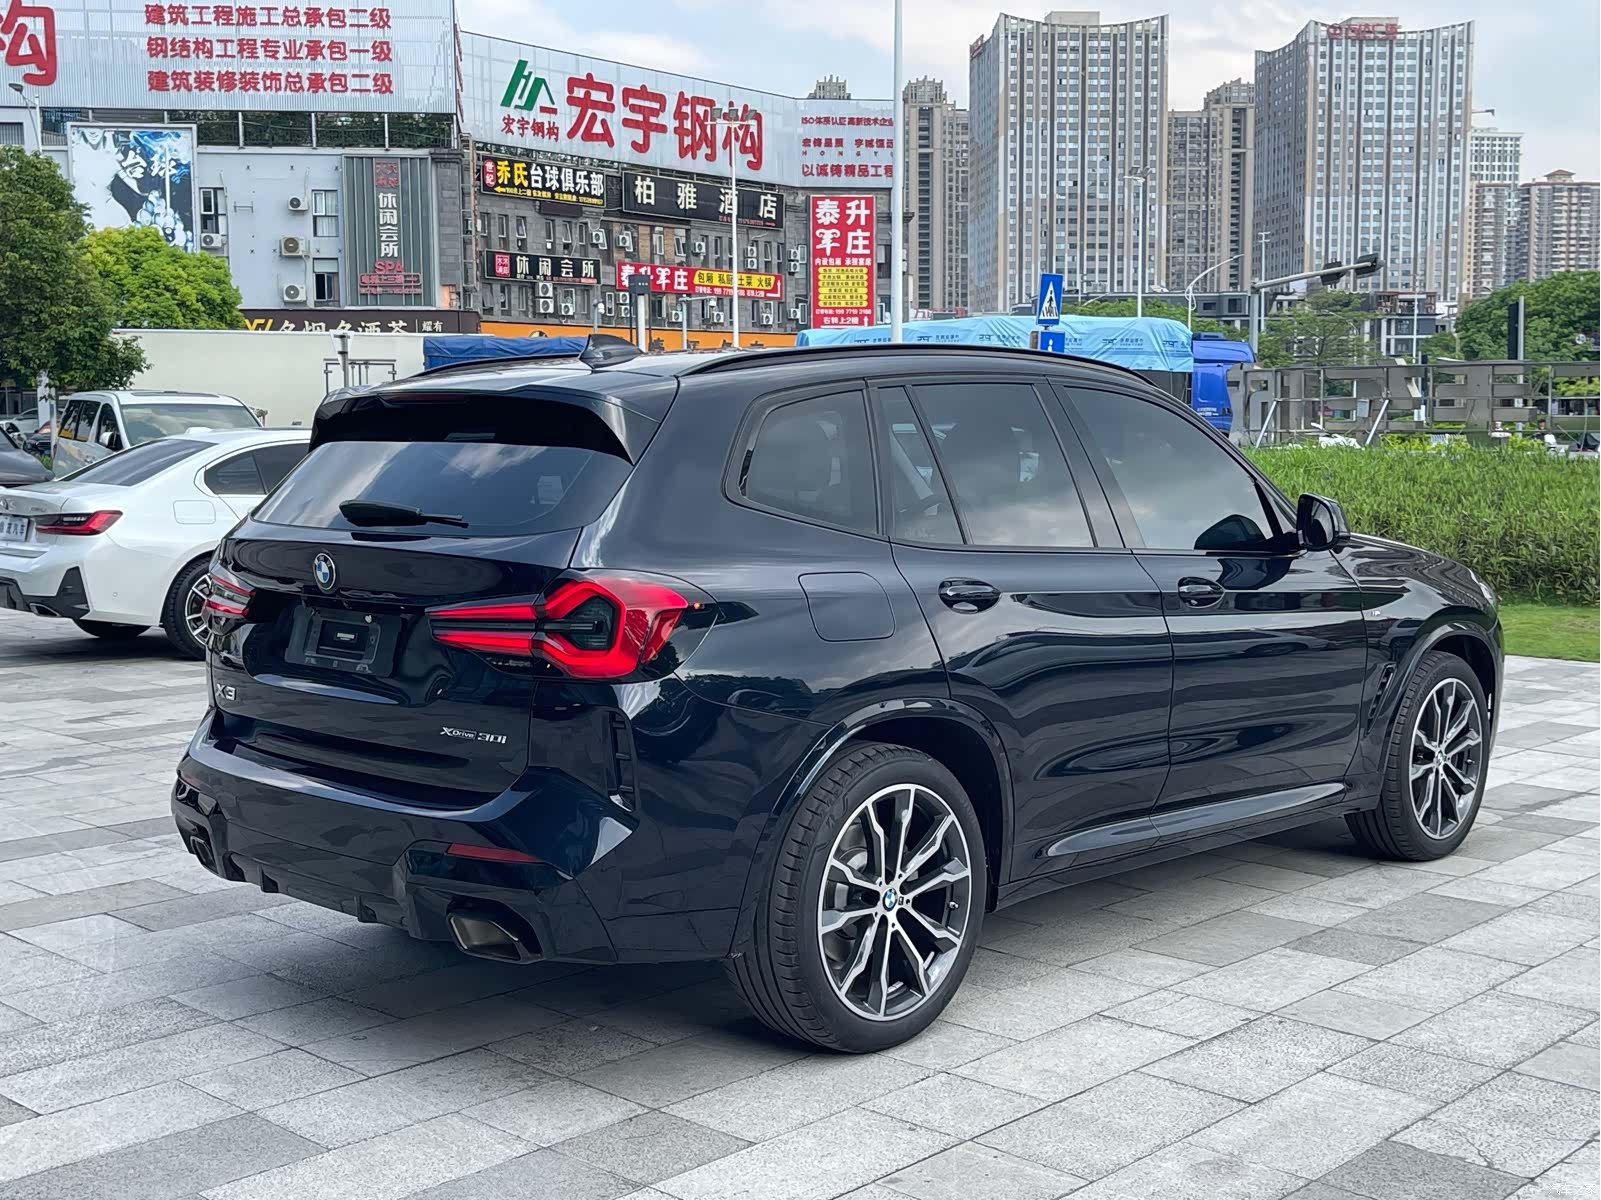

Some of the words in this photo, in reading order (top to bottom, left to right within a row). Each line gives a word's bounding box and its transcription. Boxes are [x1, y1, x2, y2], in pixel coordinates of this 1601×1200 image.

[144, 4, 392, 29] 建筑工程施工总承包二级
[146, 36, 393, 62] 钢结构工程专业承包一级
[147, 70, 394, 94] 建筑装修装饰总承包二级
[501, 114, 560, 142] 宏宇钢构
[566, 72, 763, 171] 宏宇钢构
[497, 160, 604, 196] 乔氏台球俱乐部
[635, 176, 777, 220] 柏雅酒店
[378, 192, 399, 258] 休闲会所
[815, 199, 871, 226] 泰升
[517, 256, 594, 278] 休闲会所
[215, 683, 236, 700] X3
